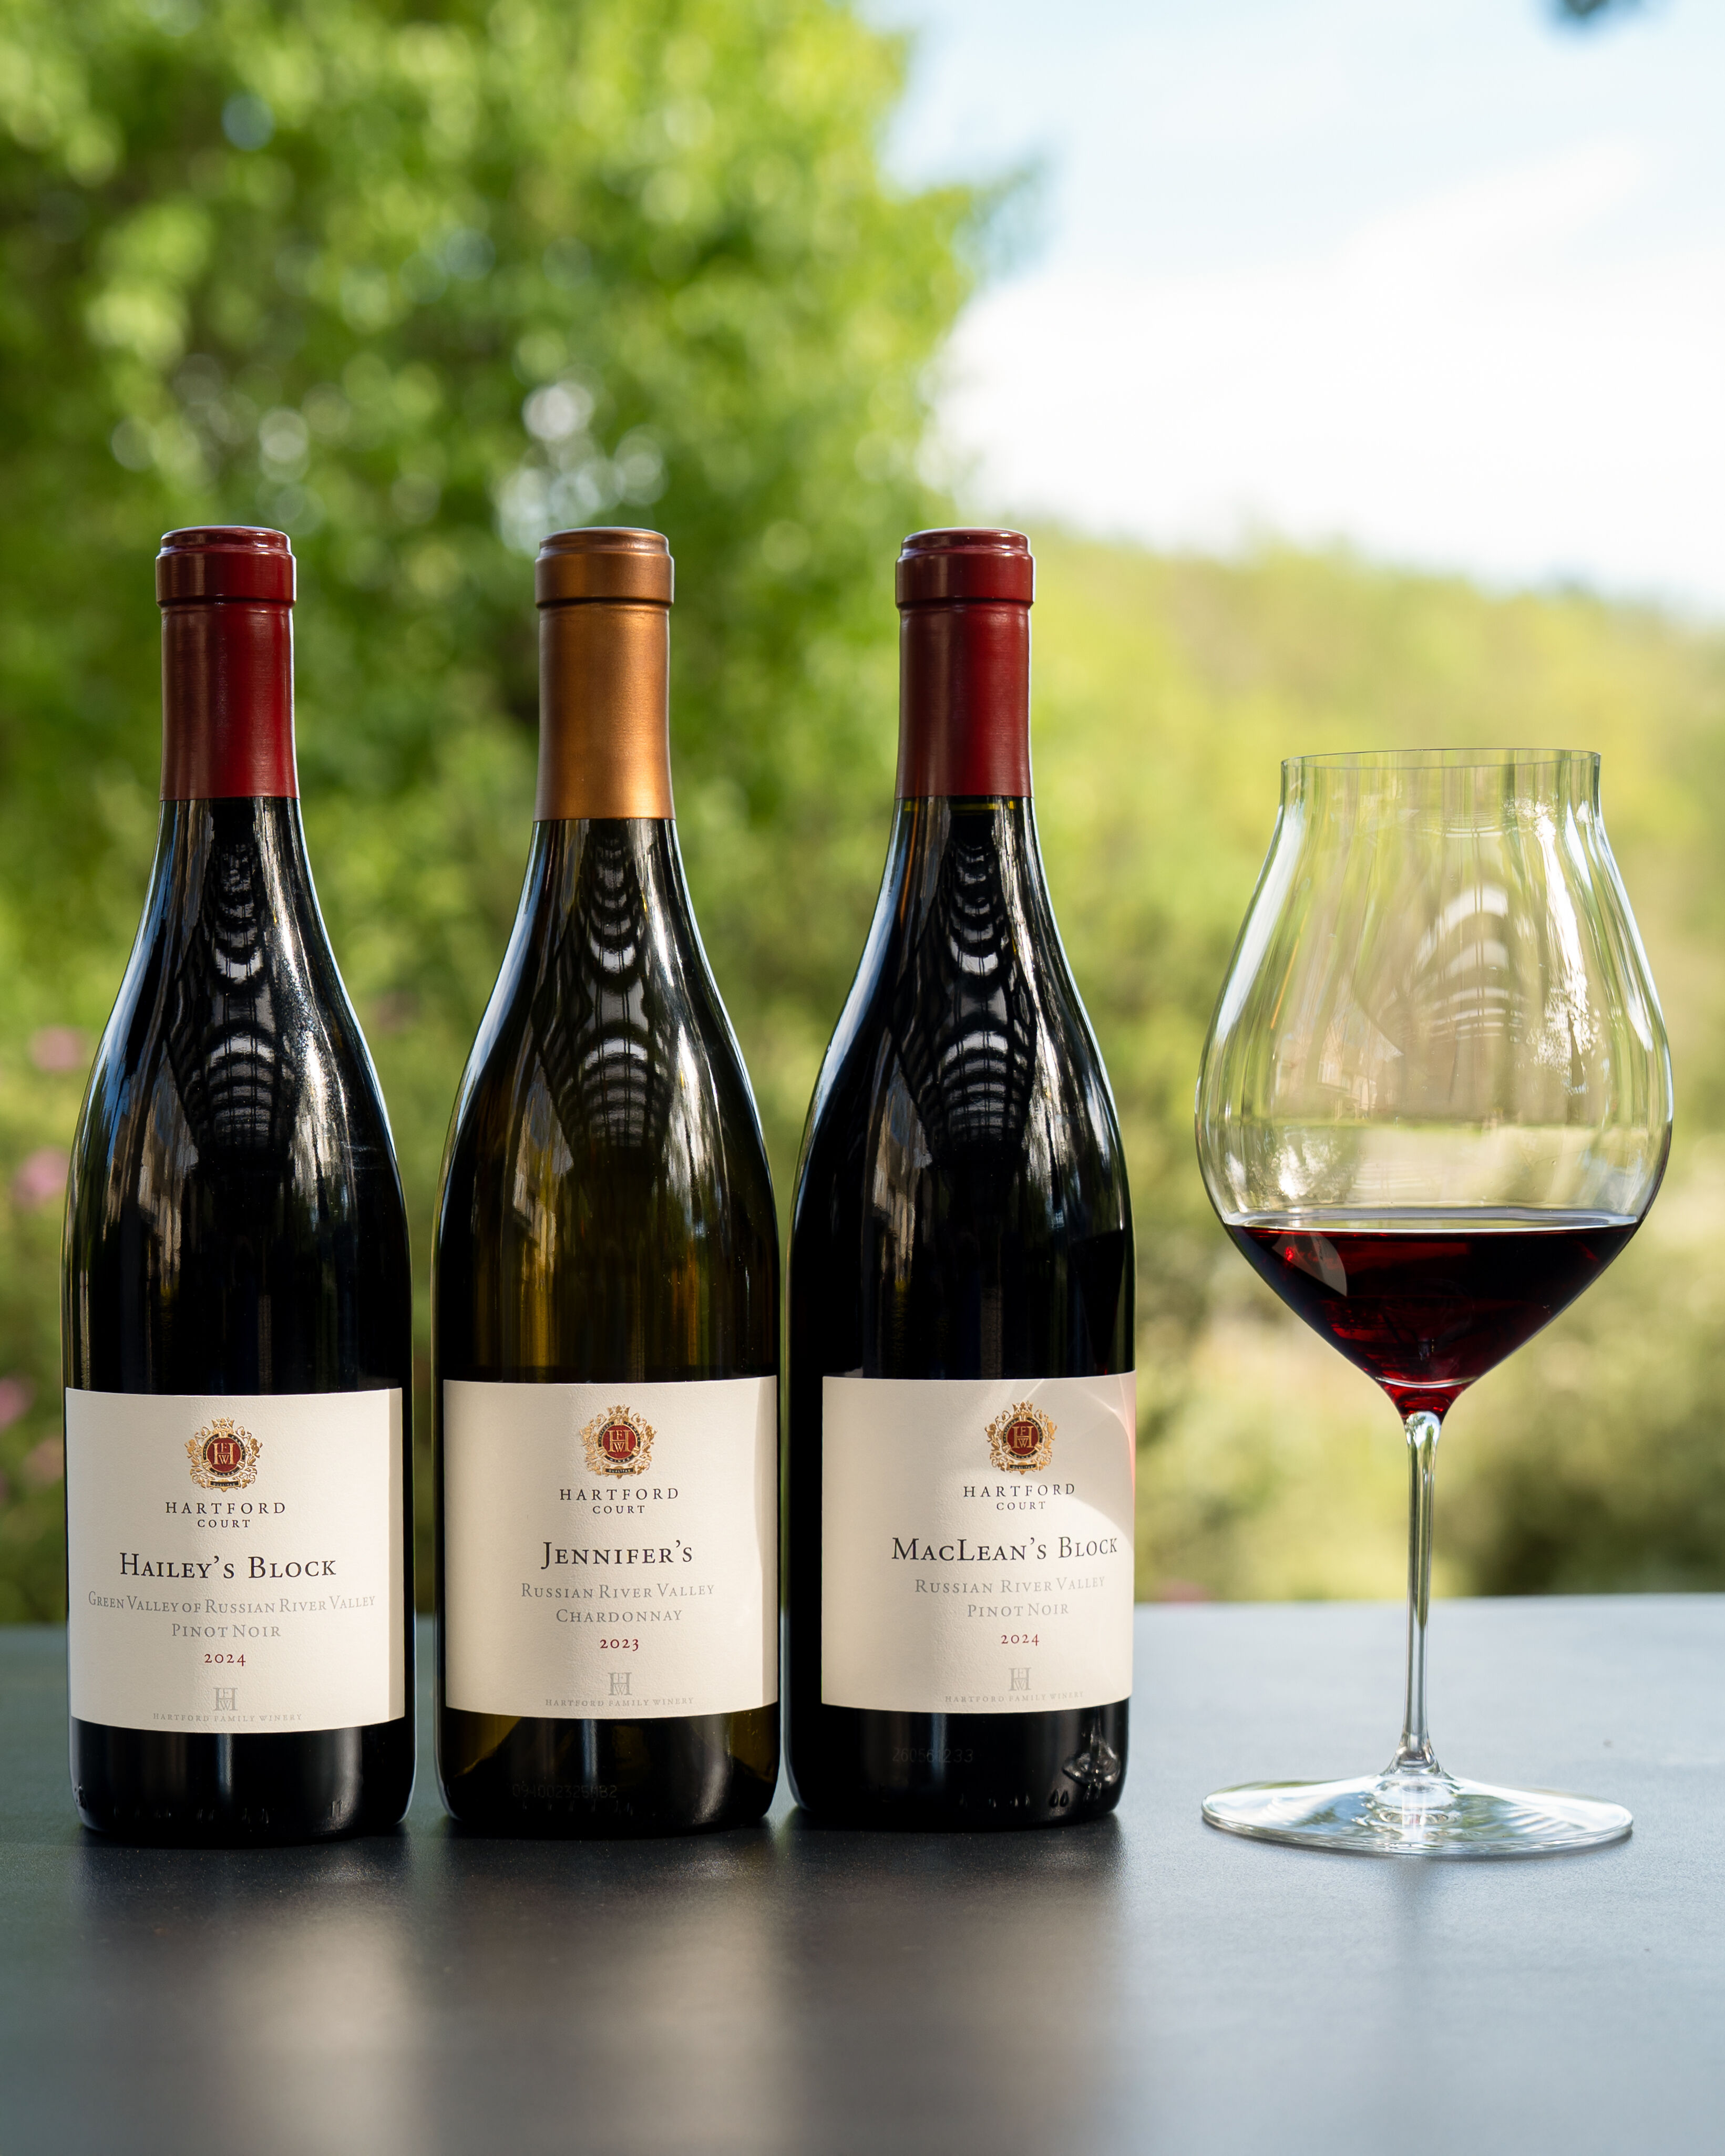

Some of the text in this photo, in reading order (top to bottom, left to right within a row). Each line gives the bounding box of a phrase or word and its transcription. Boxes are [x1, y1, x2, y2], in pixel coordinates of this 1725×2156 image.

[559, 1488, 679, 1501] HARTFORD
[963, 1483, 1075, 1498] HARTFORD
[166, 1502, 285, 1514] HARTFORD
[592, 1505, 645, 1514] COURT
[996, 1501, 1046, 1511] COURT
[197, 1519, 250, 1528] COURT
[600, 1638, 639, 1652] 2023
[1001, 1634, 1040, 1646] 2024
[204, 1653, 247, 1667] 2024
[1050, 1691, 1083, 1699] WINERY
[652, 1697, 694, 1706] WINERY
[153, 1713, 209, 1722] HARTFORD
